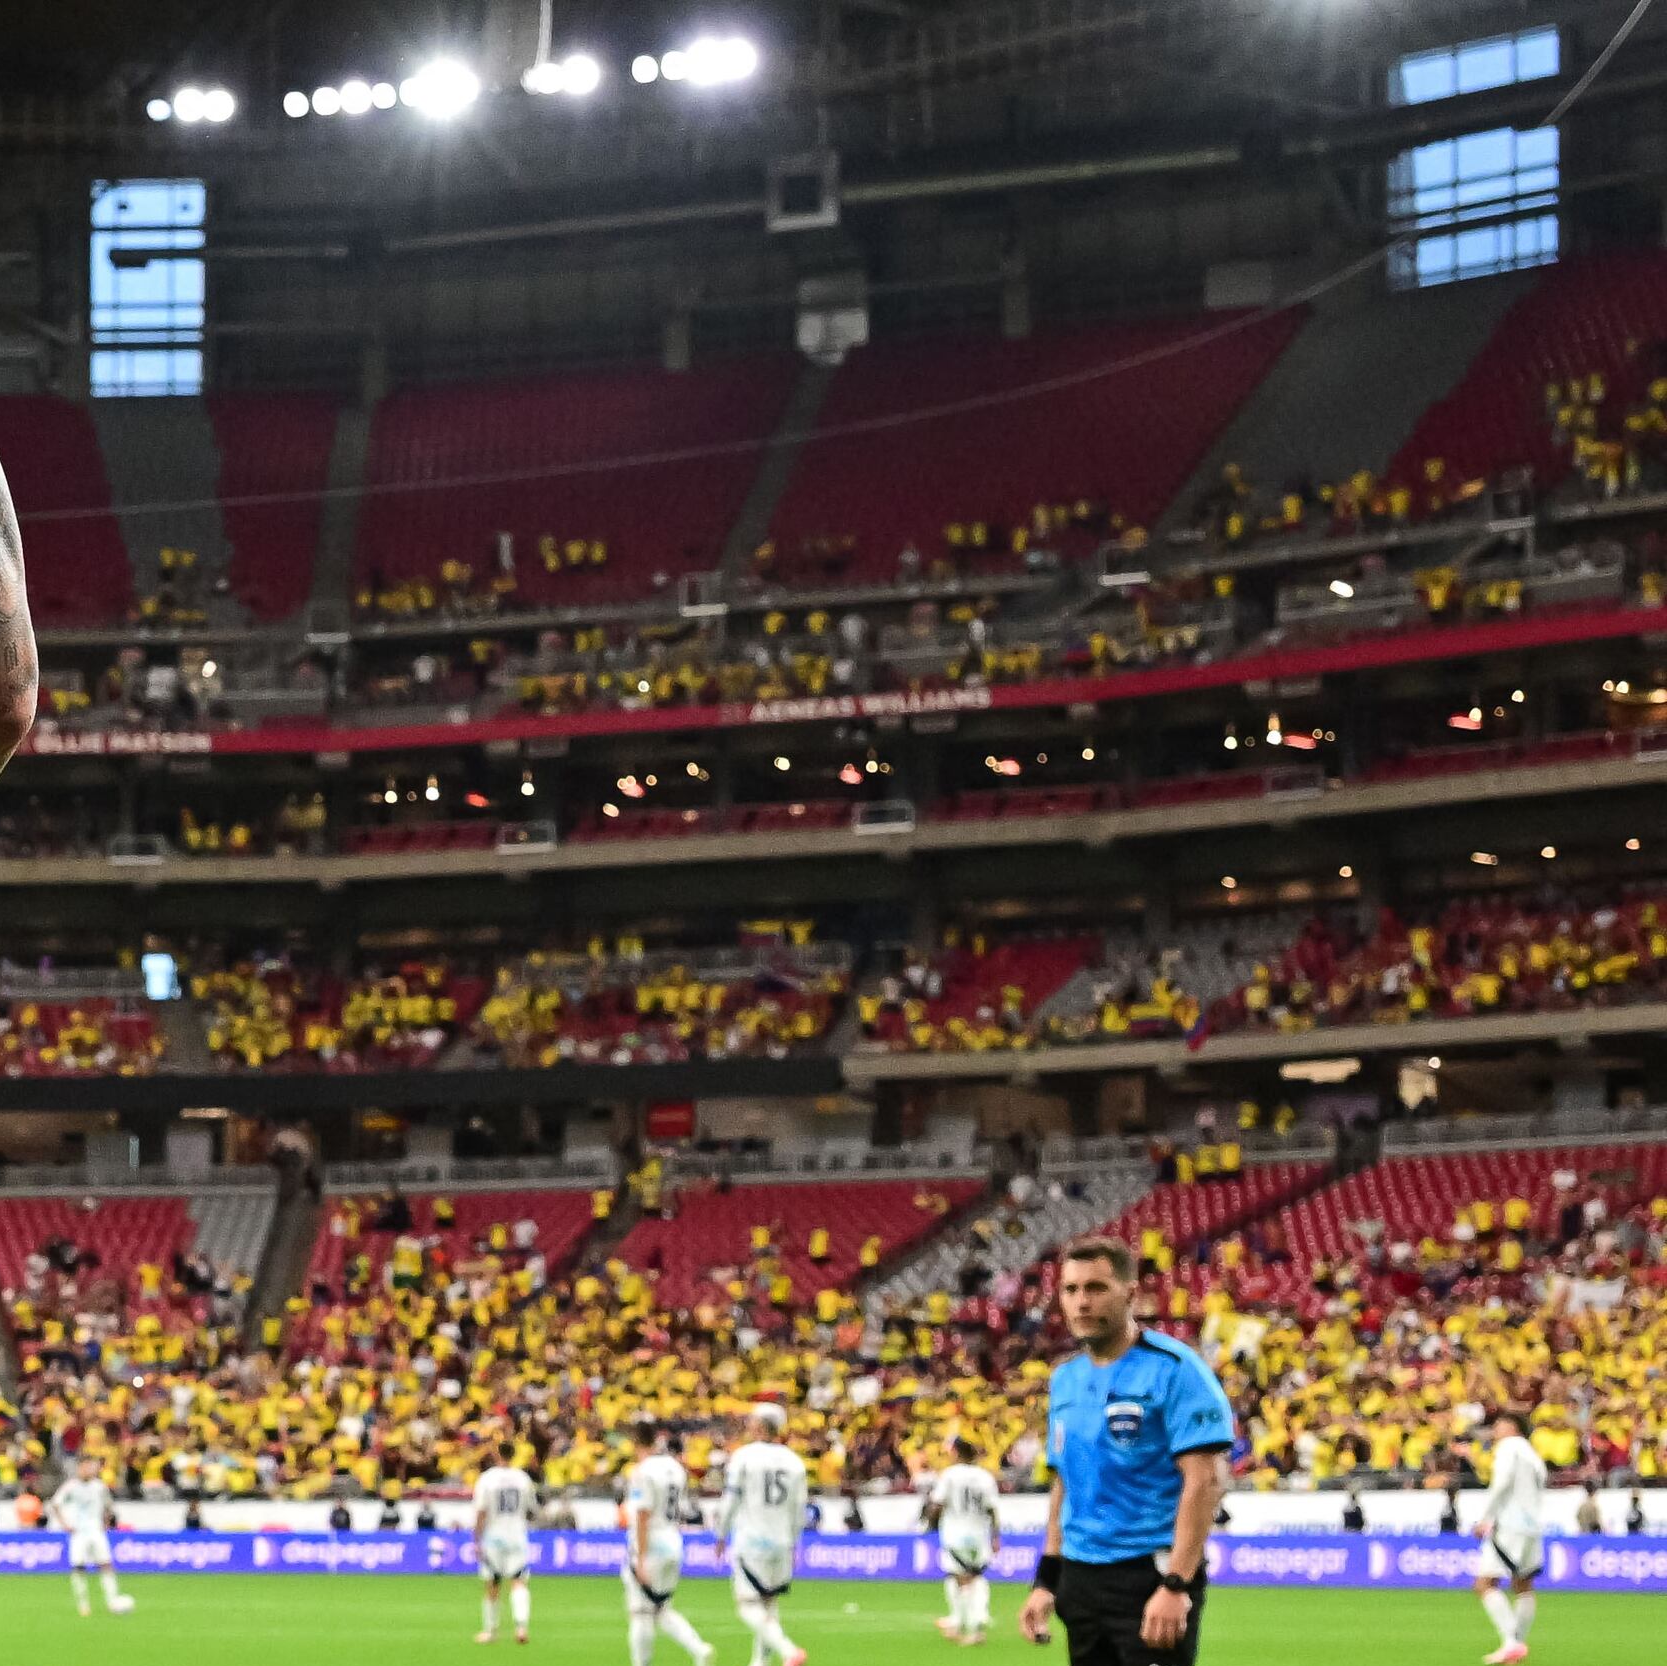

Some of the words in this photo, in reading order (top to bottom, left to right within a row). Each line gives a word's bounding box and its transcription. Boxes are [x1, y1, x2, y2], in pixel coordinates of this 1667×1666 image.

[115, 1540, 234, 1569] despegar
[281, 1540, 405, 1569] despegar
[806, 1544, 899, 1574] despegar
[1231, 1544, 1349, 1580] despegar
[1398, 1544, 1478, 1581] despe
[1580, 1545, 1667, 1583] despe
